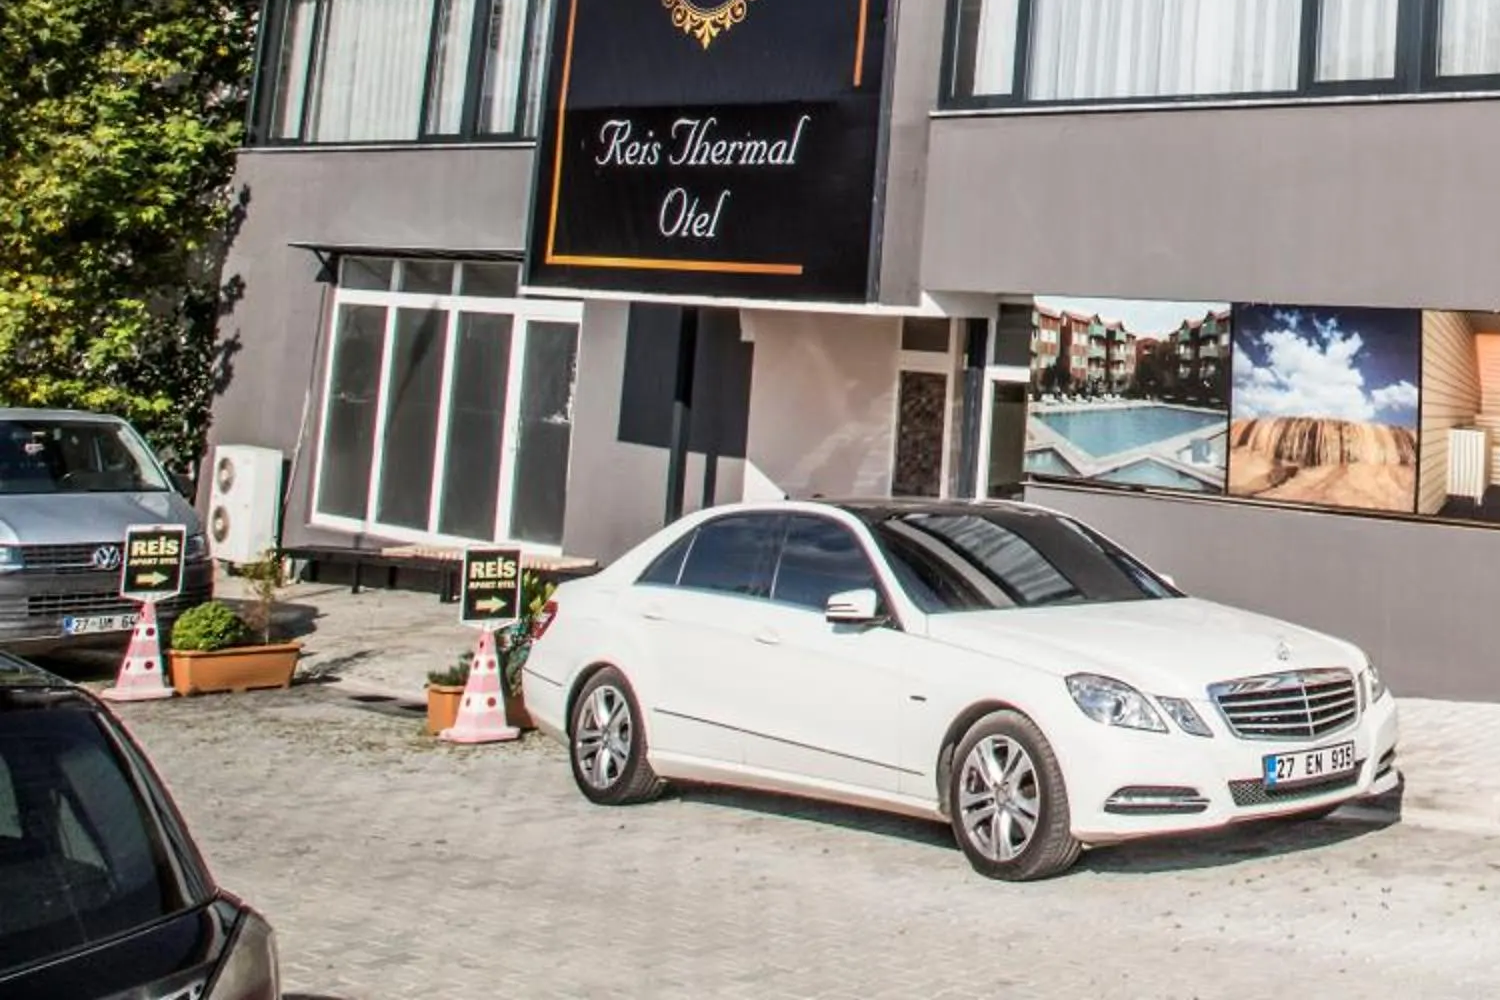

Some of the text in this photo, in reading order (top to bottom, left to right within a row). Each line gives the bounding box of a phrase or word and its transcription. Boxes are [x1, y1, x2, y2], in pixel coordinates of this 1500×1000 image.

[595, 115, 811, 165] Reis Thermal
[659, 187, 731, 237] Otel
[1277, 757, 1294, 778] 27
[1306, 752, 1323, 774] EN
